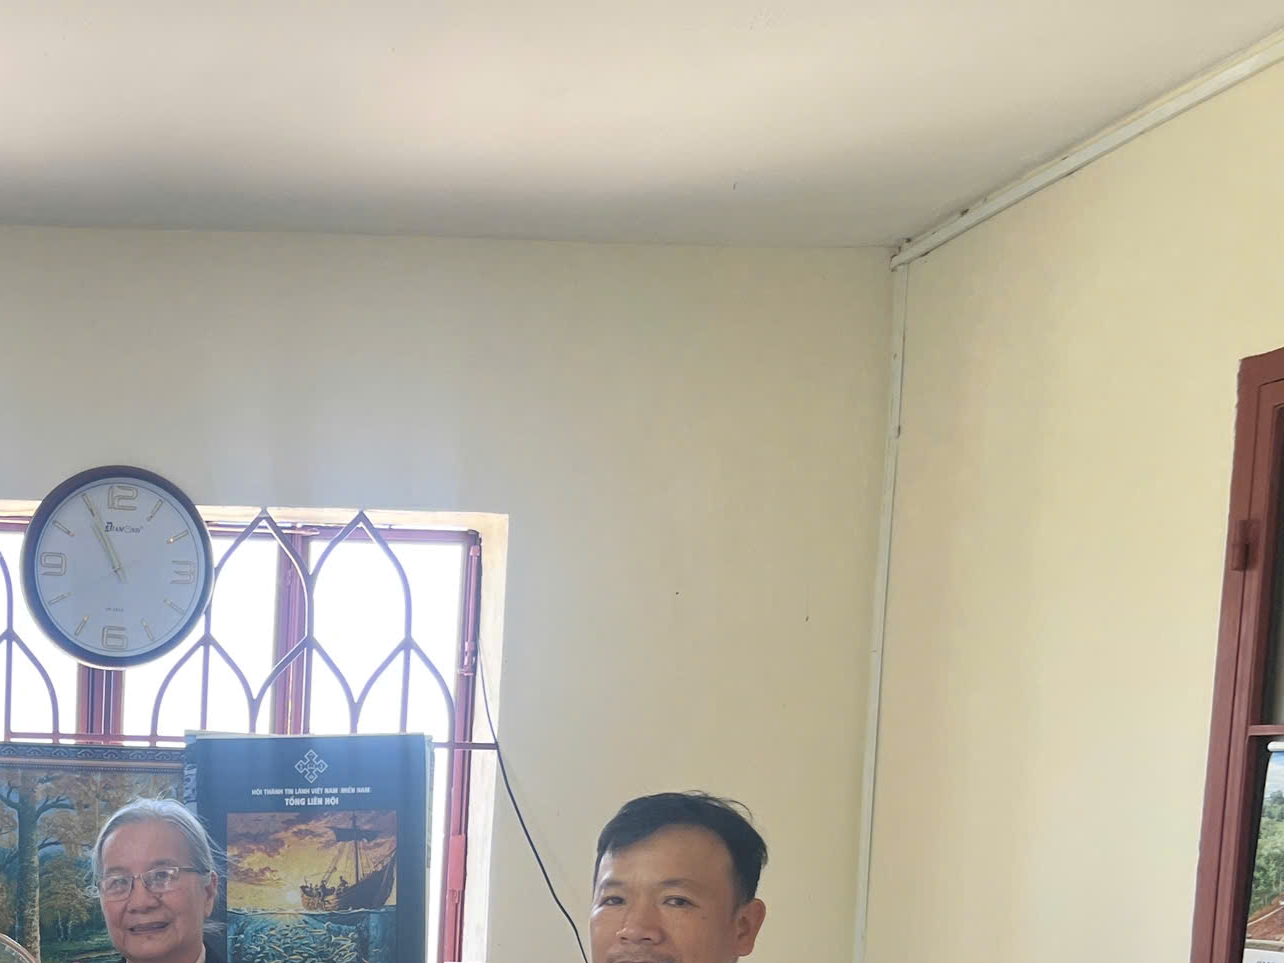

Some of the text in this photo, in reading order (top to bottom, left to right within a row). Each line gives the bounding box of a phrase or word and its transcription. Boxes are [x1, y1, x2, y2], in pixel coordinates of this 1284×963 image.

[107, 485, 139, 512] 12
[40, 551, 68, 577] 9
[169, 559, 196, 585] 3
[101, 625, 129, 650] 6
[284, 787, 294, 795] TIN
